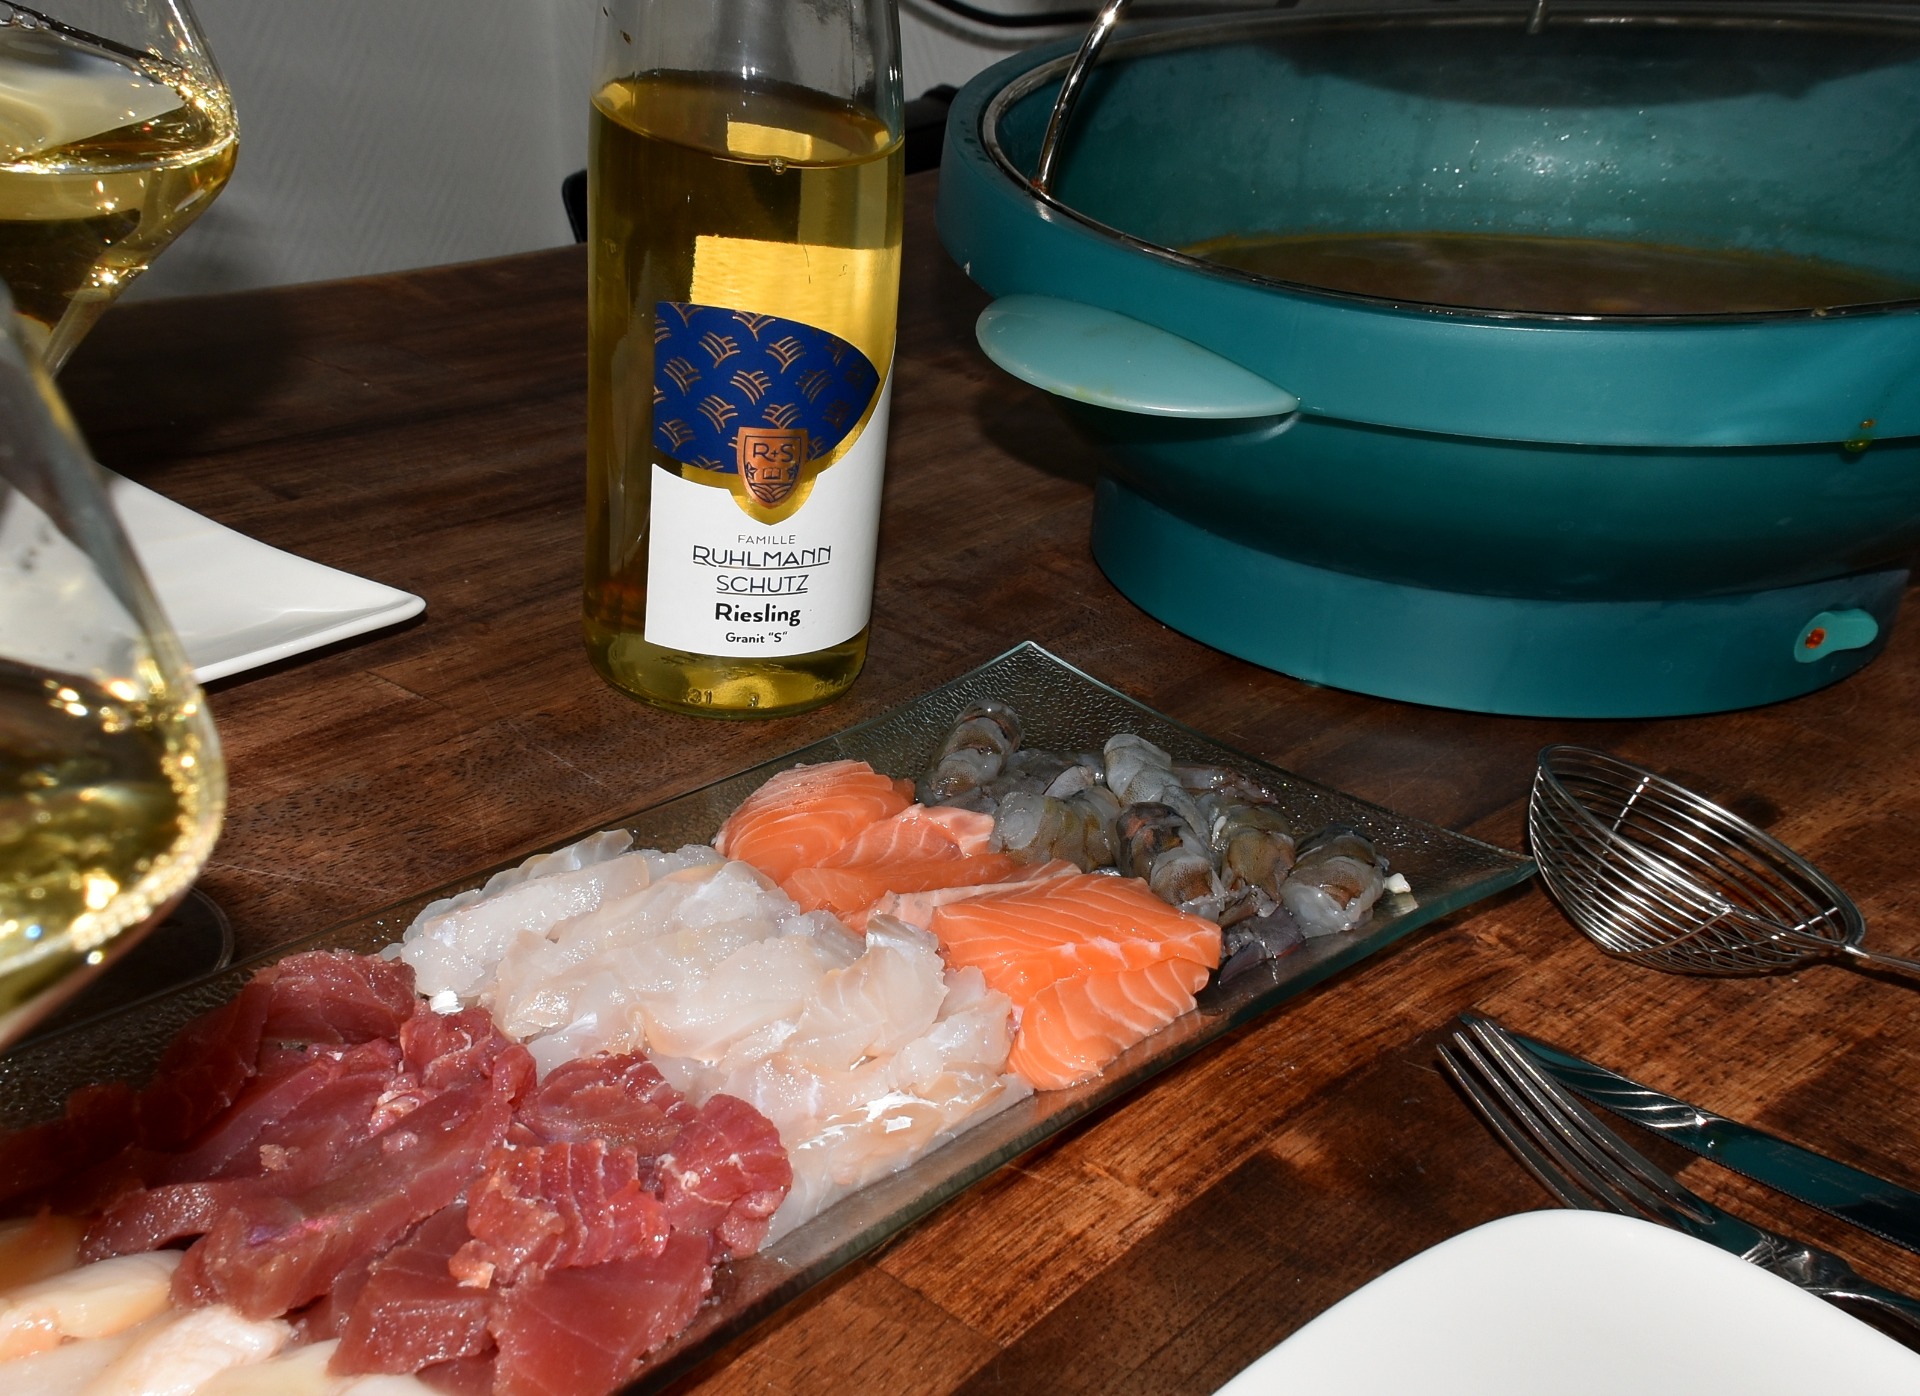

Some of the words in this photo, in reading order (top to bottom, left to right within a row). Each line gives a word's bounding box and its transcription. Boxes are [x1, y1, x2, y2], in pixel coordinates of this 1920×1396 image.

[737, 534, 796, 545] FAMILLE
[692, 545, 832, 568] RUHLMANN
[716, 574, 809, 594] SCHUTZ
[715, 602, 801, 627] Riesling
[725, 632, 765, 644] Granit
